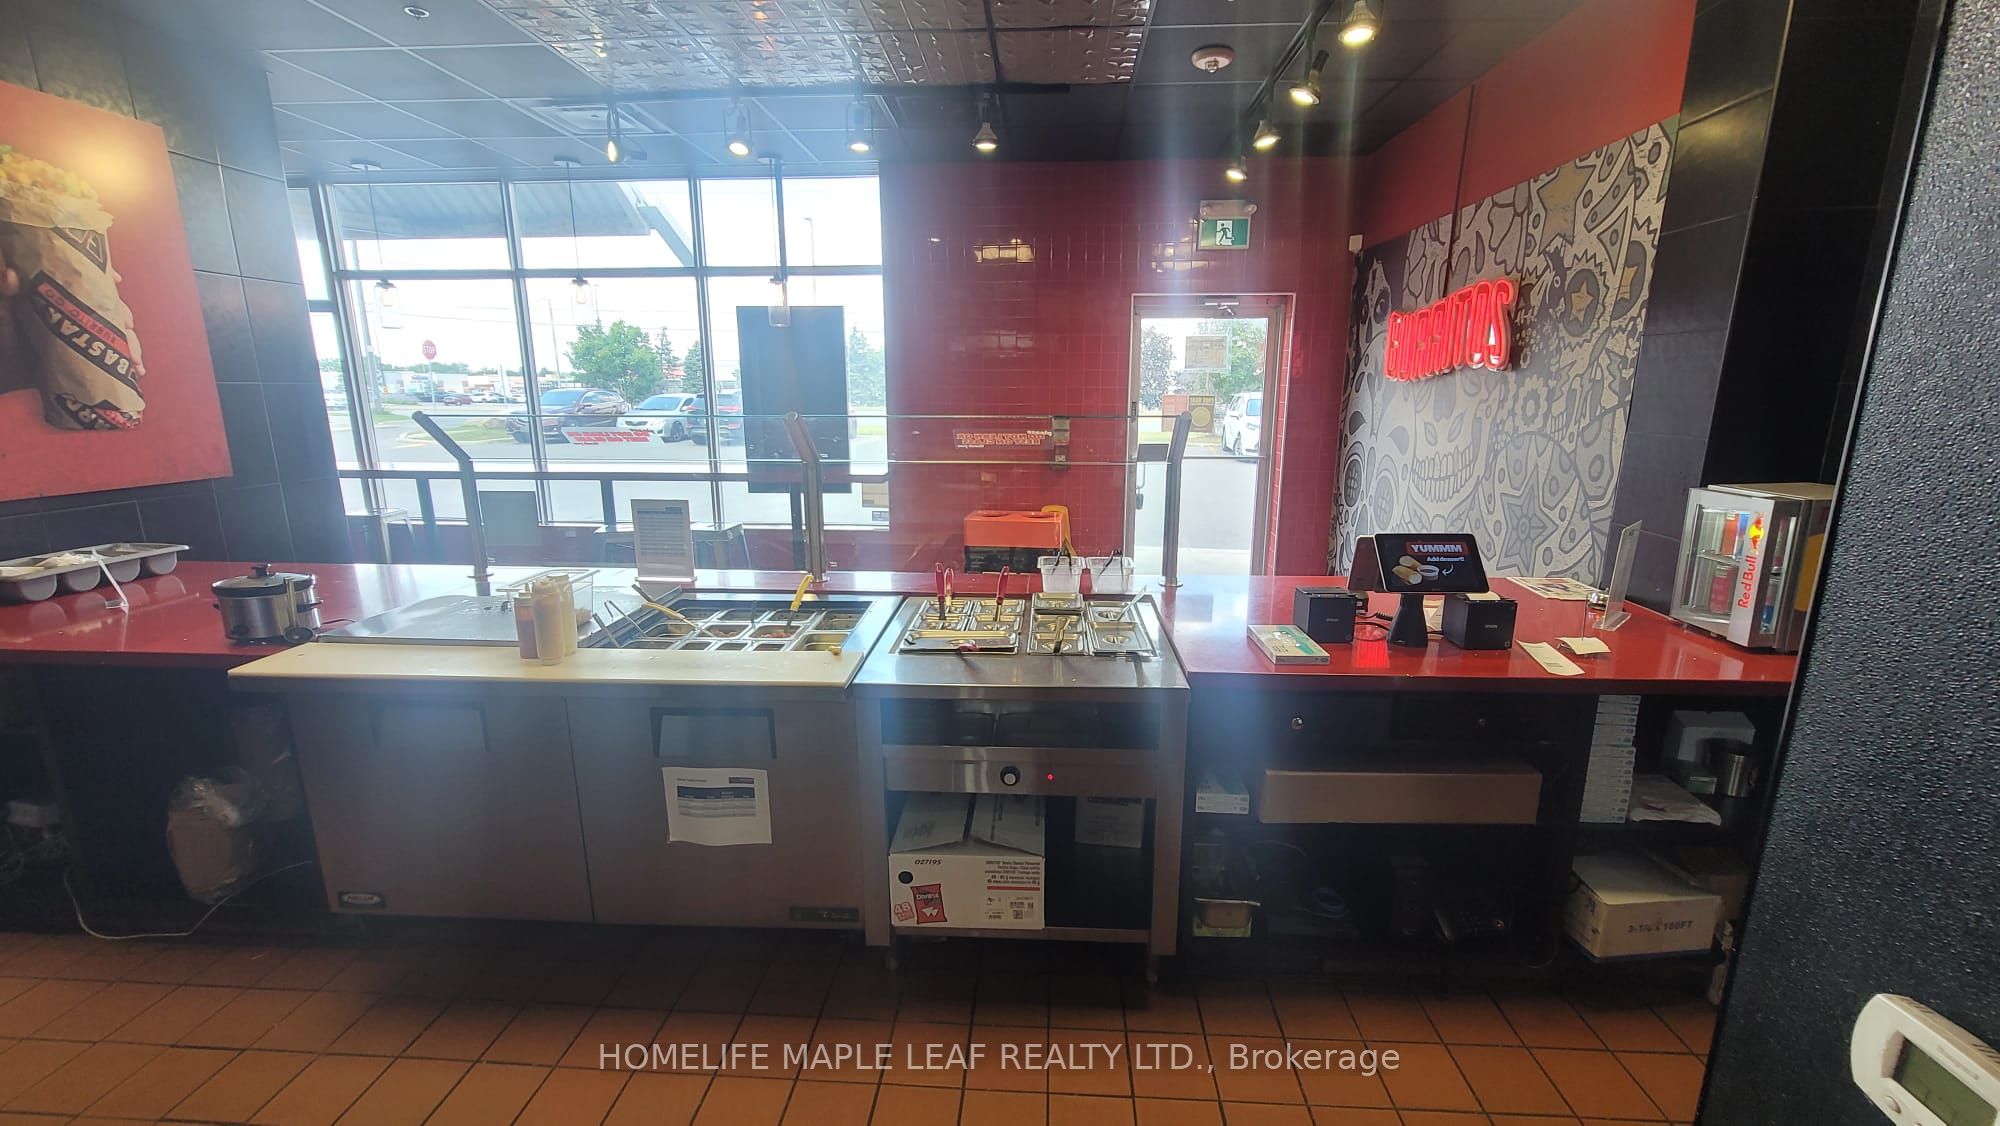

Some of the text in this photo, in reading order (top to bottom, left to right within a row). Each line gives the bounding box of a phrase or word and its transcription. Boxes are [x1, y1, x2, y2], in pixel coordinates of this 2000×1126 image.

[1411, 544, 1463, 553] YUMMM
[1738, 555, 1758, 609] Red Bull
[894, 902, 910, 914] 48
